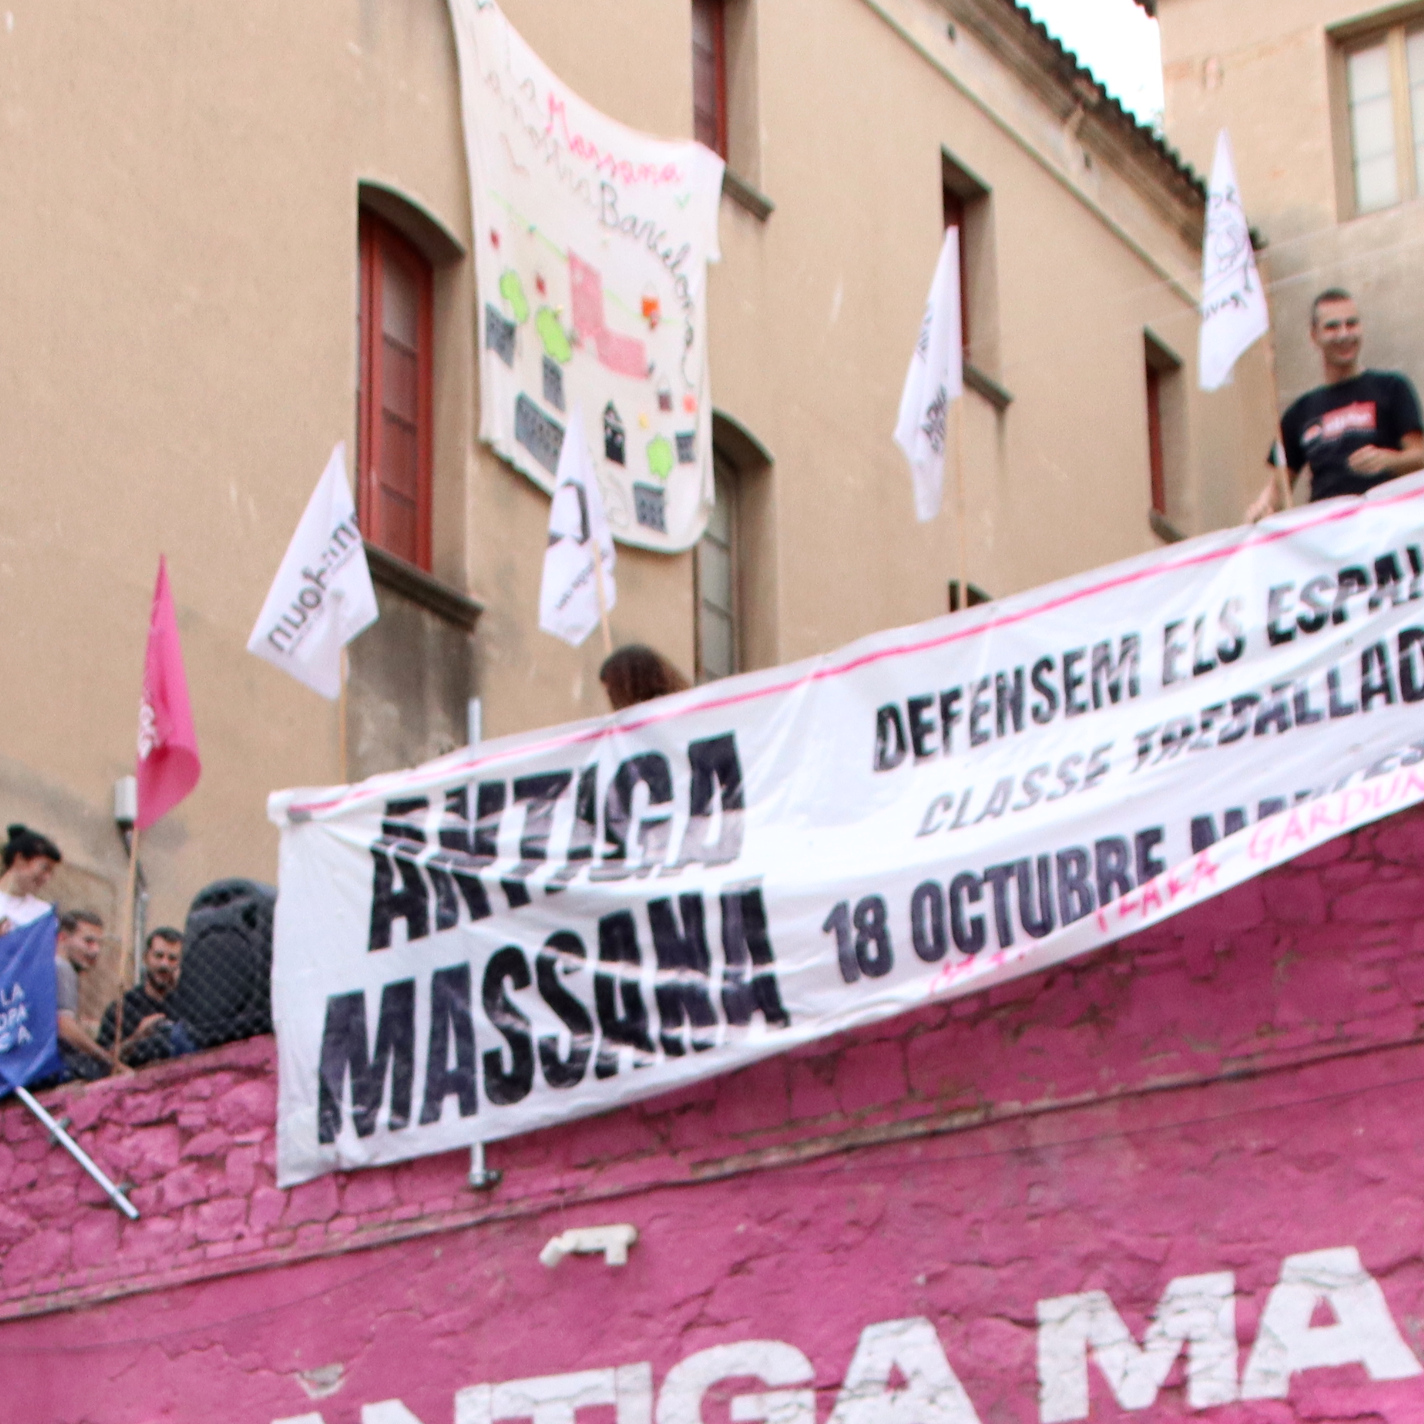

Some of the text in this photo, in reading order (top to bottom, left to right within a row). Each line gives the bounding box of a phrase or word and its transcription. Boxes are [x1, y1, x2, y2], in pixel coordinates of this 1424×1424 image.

[874, 631, 1142, 772] DEFENSEM
[1161, 597, 1247, 687] ELS
[368, 732, 744, 952] ANTIGA
[915, 742, 1115, 839] CLASSE
[821, 897, 895, 984] 18
[910, 827, 1169, 964] OCTUBRE
[317, 876, 791, 1145] MASSANA
